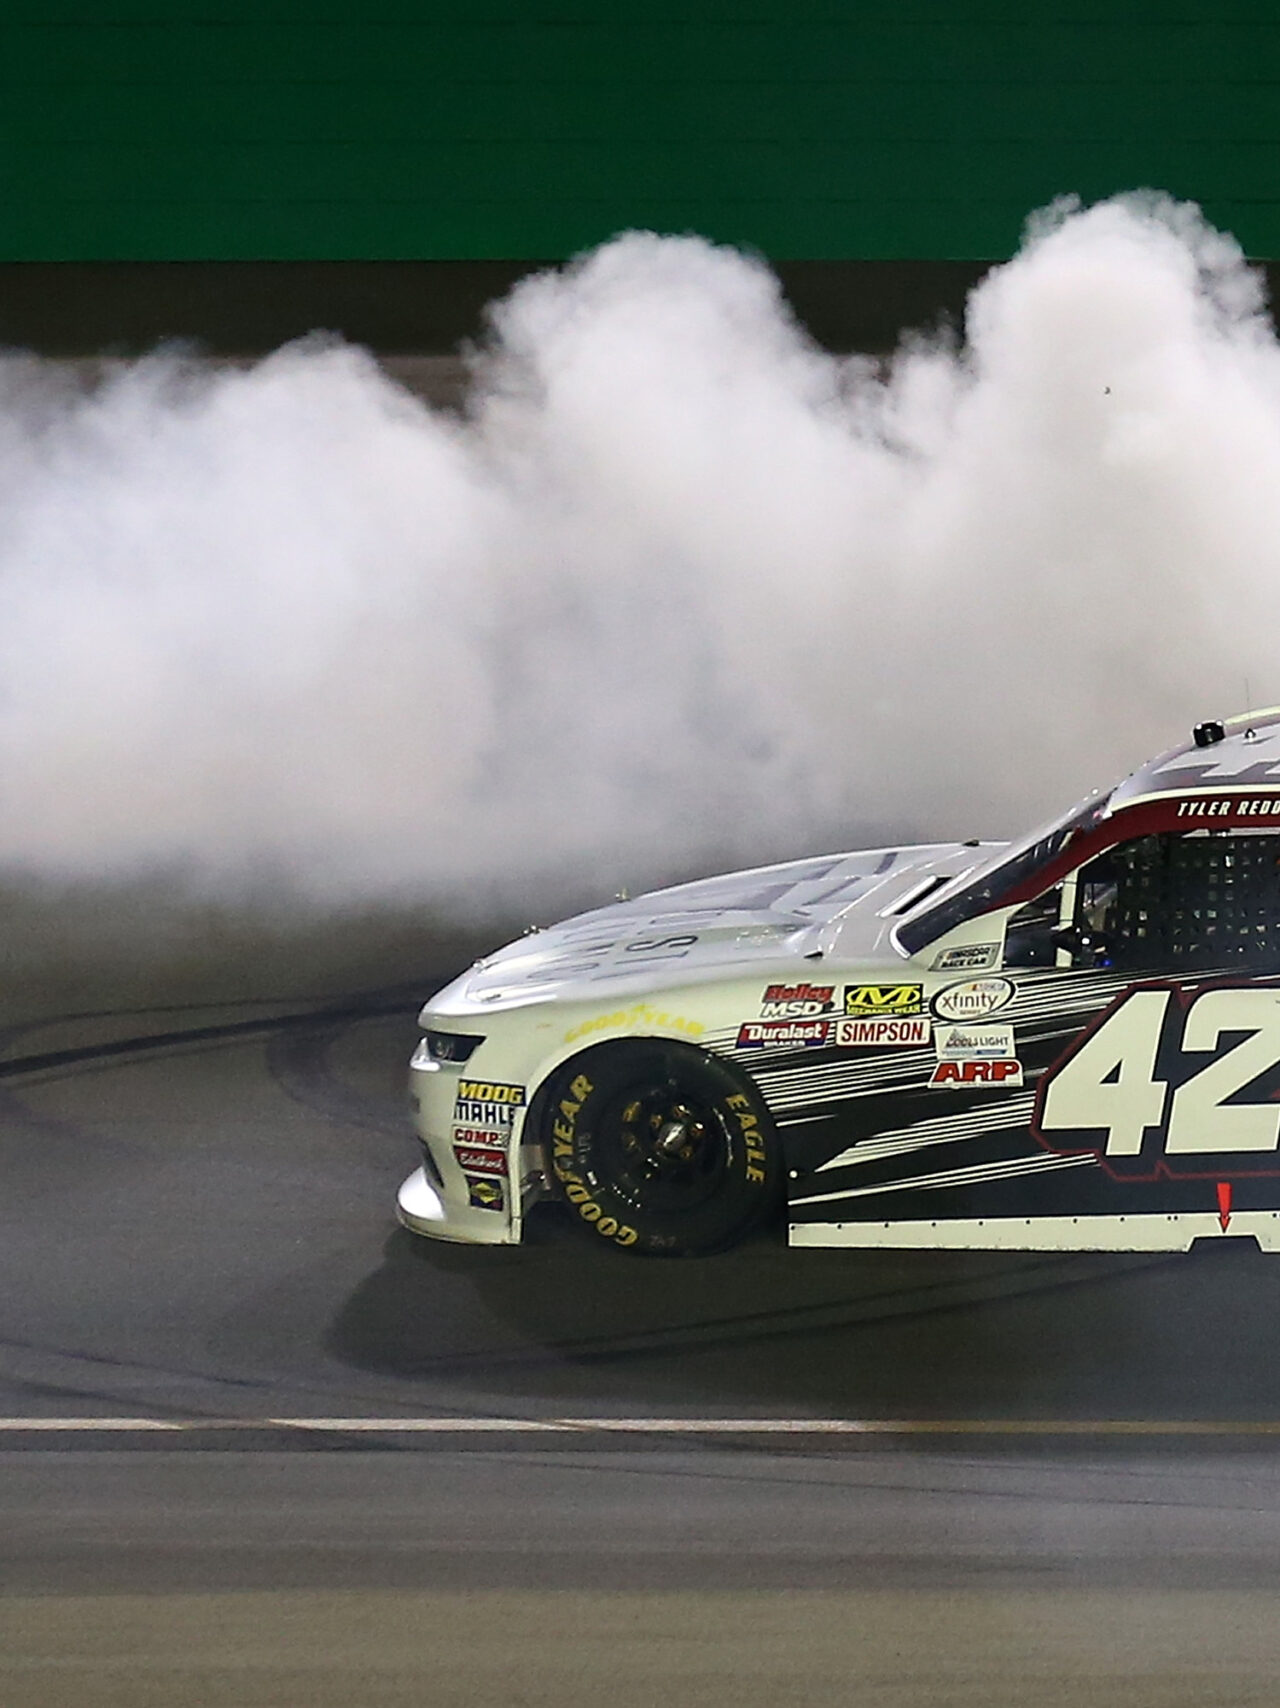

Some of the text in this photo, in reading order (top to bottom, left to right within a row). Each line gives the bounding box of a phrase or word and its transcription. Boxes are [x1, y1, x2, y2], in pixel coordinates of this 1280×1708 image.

[1177, 801, 1231, 816] TYLER
[762, 1002, 823, 1017] MSD
[942, 992, 998, 1011] xfinity
[745, 1024, 823, 1041] Duralast
[841, 1022, 924, 1042] SIMPSON
[932, 1061, 1020, 1082] ARP
[459, 1081, 523, 1104] MOOG
[726, 1092, 768, 1184] EAGLE
[551, 1074, 638, 1247] GOODYEAR
